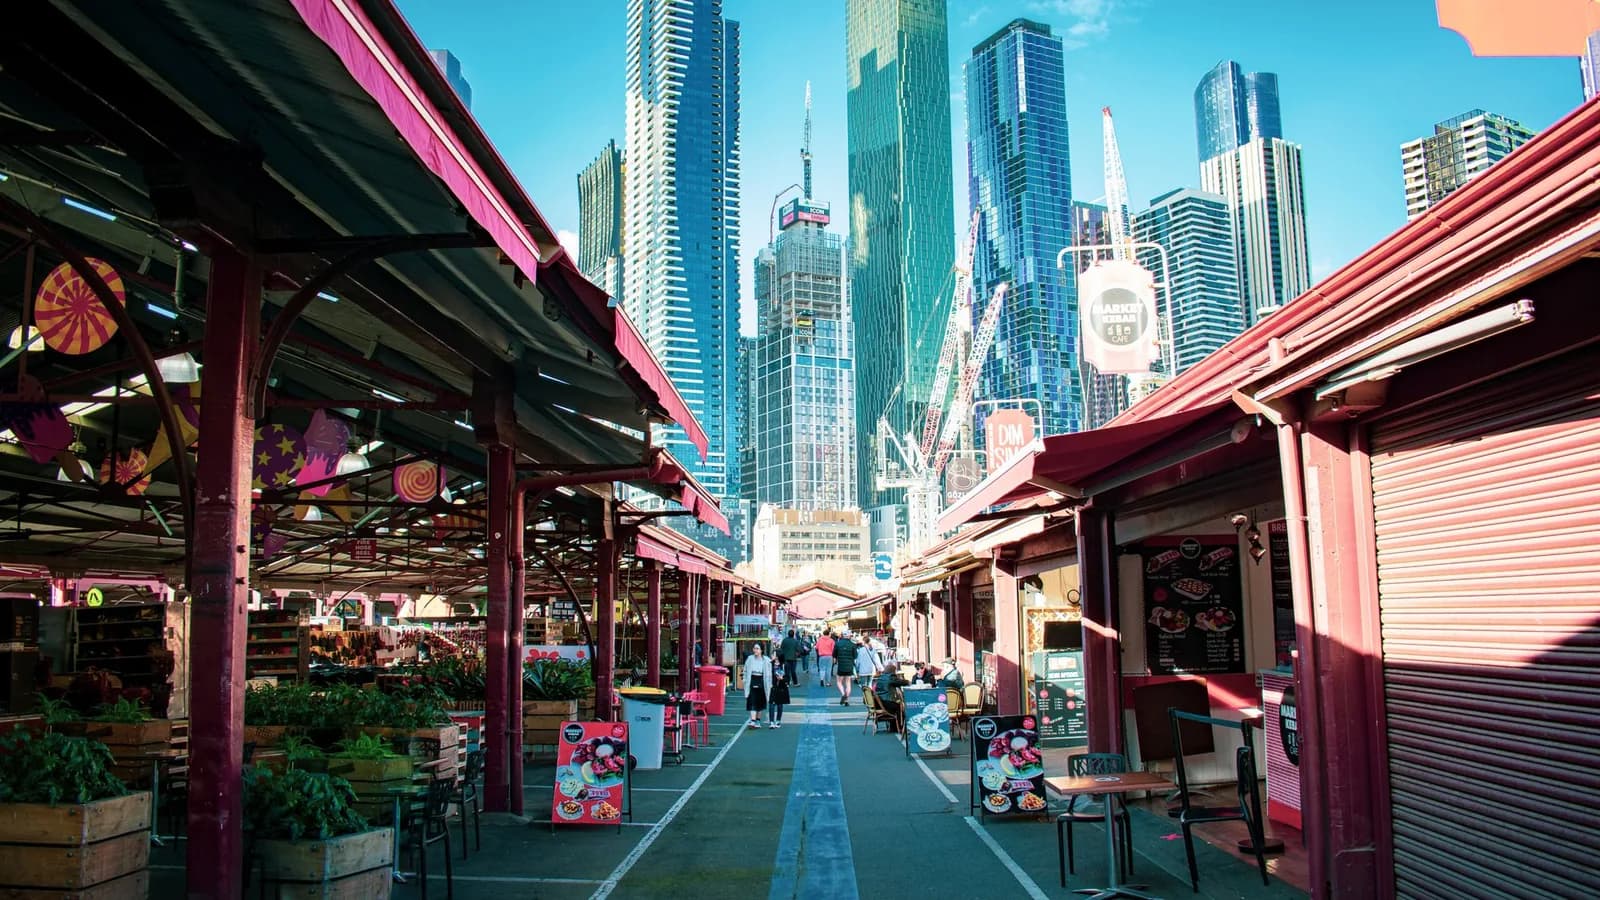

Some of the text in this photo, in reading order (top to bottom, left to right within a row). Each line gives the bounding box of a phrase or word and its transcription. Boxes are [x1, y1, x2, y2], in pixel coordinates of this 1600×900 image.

[810, 207, 825, 215] ICON
[1092, 303, 1143, 314] MARKET
[1102, 314, 1137, 323] KEBAB
[1111, 335, 1129, 344] CAFE
[997, 423, 1025, 446] DIM
